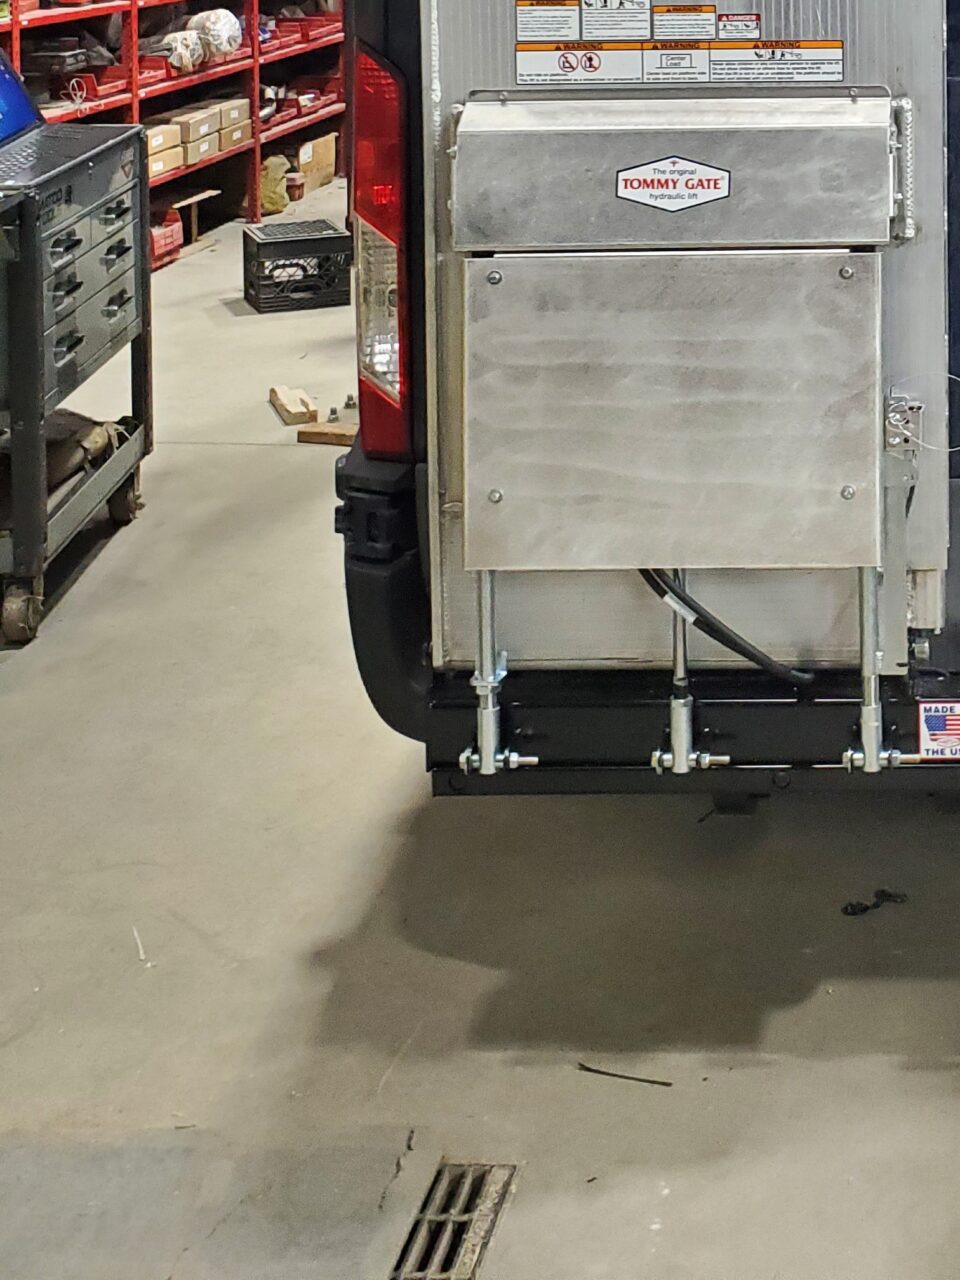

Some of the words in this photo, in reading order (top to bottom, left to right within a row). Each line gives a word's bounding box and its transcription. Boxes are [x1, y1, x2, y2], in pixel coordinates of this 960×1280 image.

[669, 168, 697, 177] original
[622, 178, 679, 190] TOMMY
[685, 178, 721, 190] GATE
[649, 193, 686, 201] hydraulic
[923, 705, 956, 714] MADE
[924, 748, 946, 756] THE
